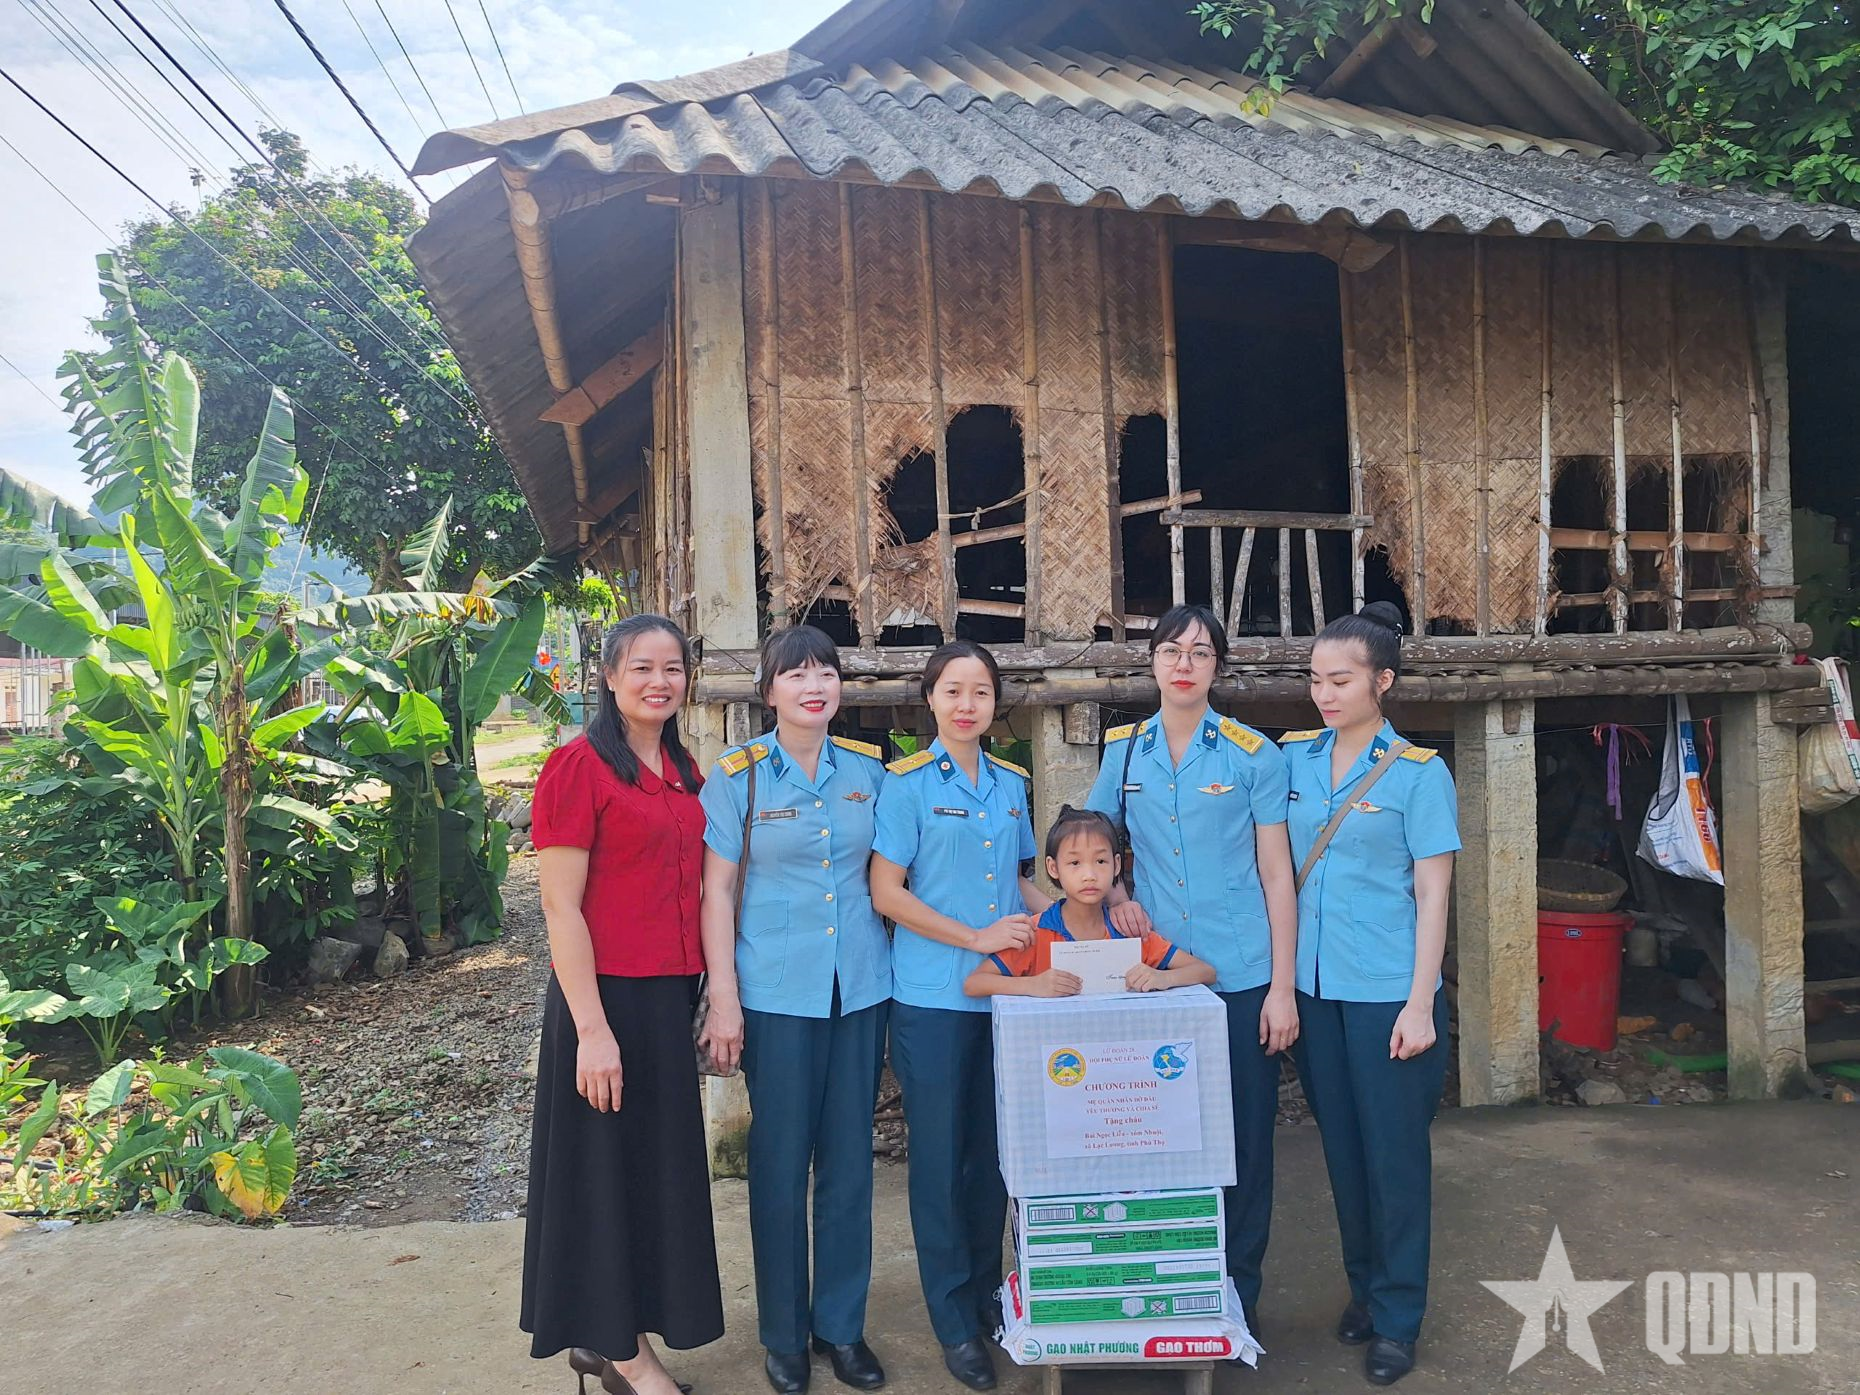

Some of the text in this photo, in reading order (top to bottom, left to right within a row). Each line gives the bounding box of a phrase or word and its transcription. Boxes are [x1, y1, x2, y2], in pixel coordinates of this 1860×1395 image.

[1085, 1079, 1157, 1091] CHƯƠNG TRÌNH
[1104, 1115, 1142, 1125] Tặng cháu
[1047, 1343, 1066, 1356] GẠO
[1070, 1341, 1096, 1355] NHẬT
[1099, 1341, 1139, 1354] PHƯƠNG
[1156, 1340, 1224, 1355] GẠO THƠM
